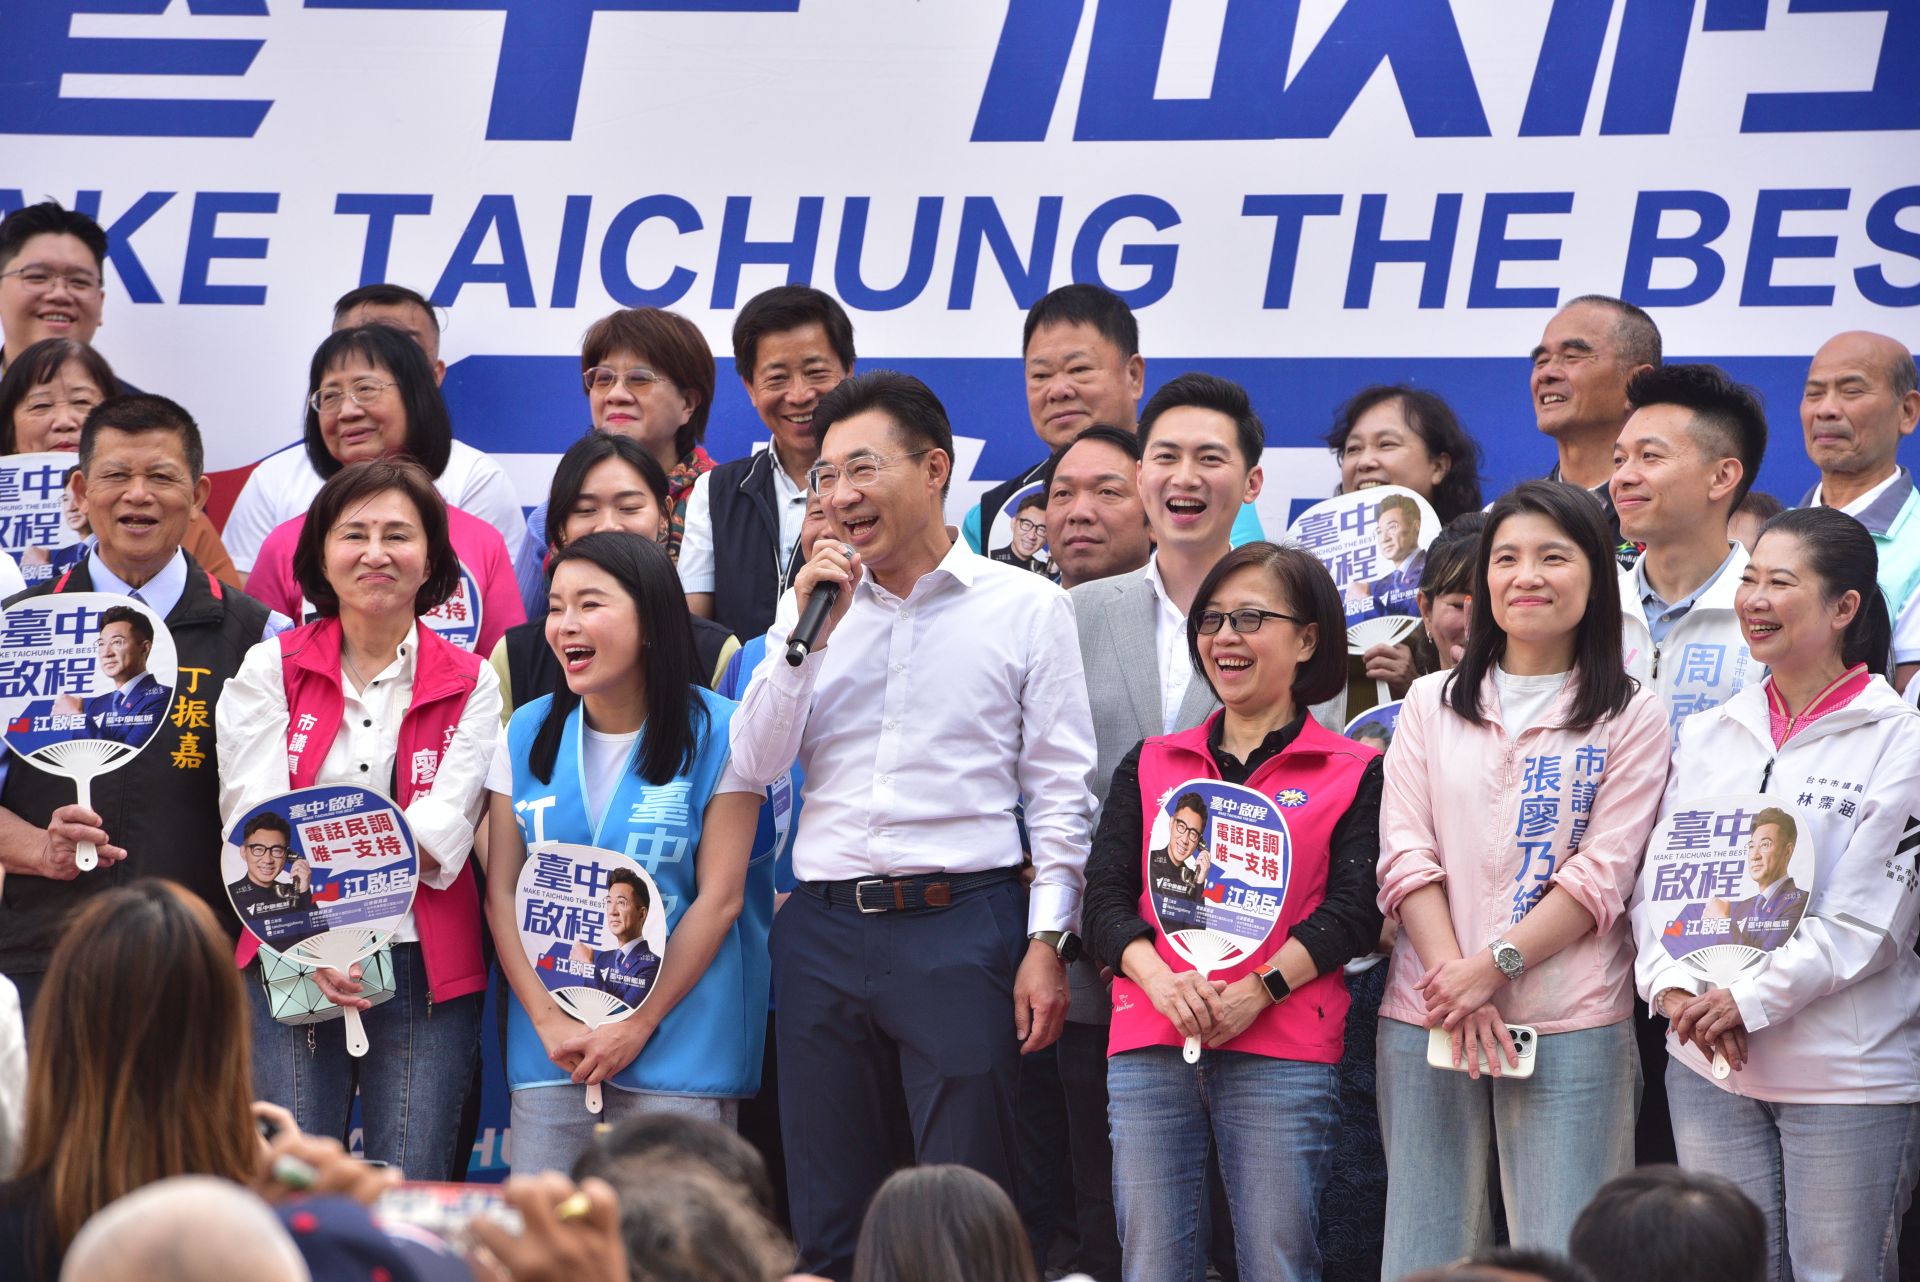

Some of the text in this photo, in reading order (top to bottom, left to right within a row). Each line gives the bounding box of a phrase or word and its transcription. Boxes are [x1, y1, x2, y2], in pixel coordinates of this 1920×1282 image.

[0, 188, 280, 306] KE
[334, 193, 1182, 312] TAICHUNG
[1241, 191, 1575, 310] THE
[0, 511, 60, 548] 程
[1297, 502, 1381, 549] 臺中
[0, 606, 105, 649] 臺中
[13, 648, 55, 658] TAICHUNG
[58, 647, 74, 655] THE
[76, 646, 98, 654] BEST
[0, 657, 97, 698] 啟程
[33, 713, 87, 732] 江啟臣
[170, 666, 212, 769] 丁振嘉
[1567, 744, 1608, 850] 市議員
[1805, 776, 1864, 794] 台中市議員
[304, 812, 394, 843] 電話民調
[1216, 821, 1280, 857] 電話民調
[1666, 808, 1759, 850] 臺中
[311, 835, 402, 864] 唯一支持
[1215, 843, 1279, 881] 唯一支持
[1653, 853, 1673, 861] MAKE
[1675, 851, 1712, 860] TAICHUNG
[1728, 849, 1748, 857] BEST
[344, 867, 412, 900] 江啟臣
[533, 852, 614, 898] 臺中
[1651, 860, 1745, 902] 啟程
[523, 886, 606, 909] MAKE TAICHUNG THE BEST
[1225, 885, 1278, 917] 江啟臣
[523, 898, 605, 947] 啟程
[1685, 917, 1731, 936] 江啟臣
[555, 956, 596, 980] 江啟臣
